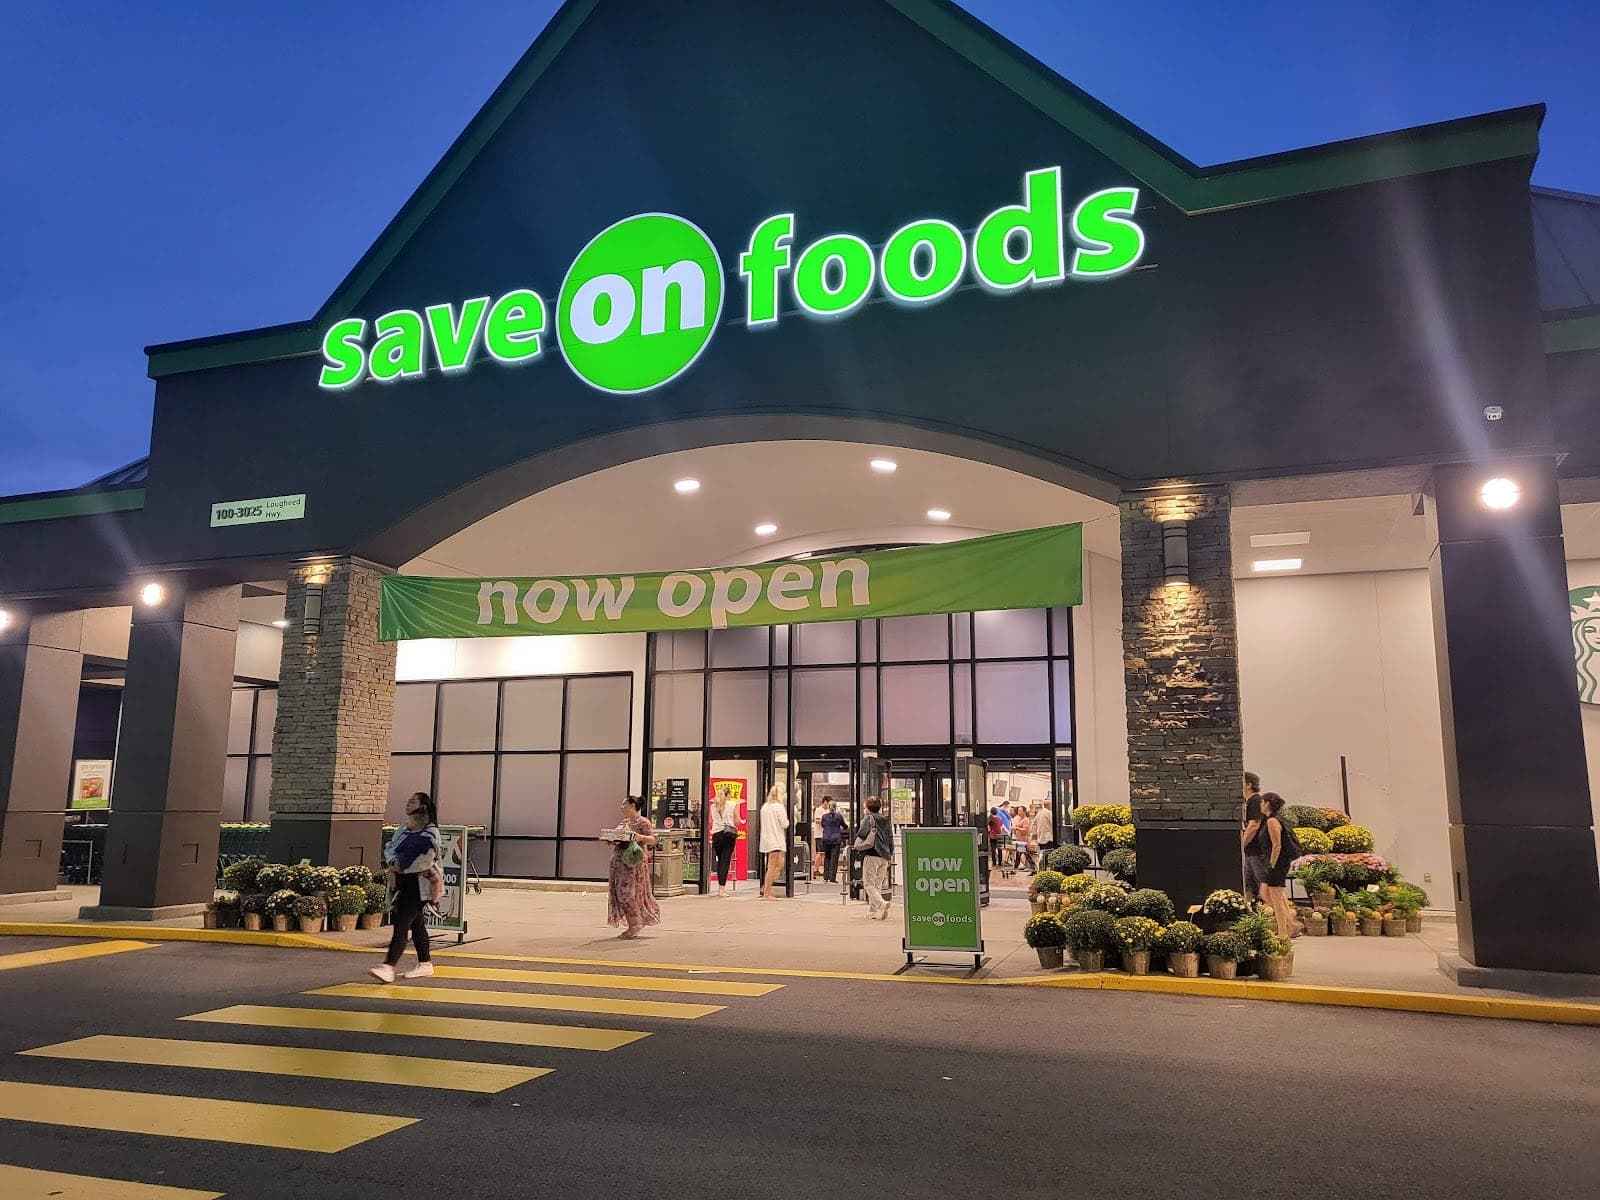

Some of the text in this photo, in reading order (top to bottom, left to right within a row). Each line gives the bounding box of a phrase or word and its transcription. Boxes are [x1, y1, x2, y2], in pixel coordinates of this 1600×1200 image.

[319, 166, 1145, 388] save on foods
[216, 498, 301, 520] 100-3025 Lougheed
[477, 557, 870, 630] now open
[917, 857, 963, 872] now
[915, 877, 970, 897] open
[912, 913, 932, 923] save
[946, 913, 973, 923] foods
